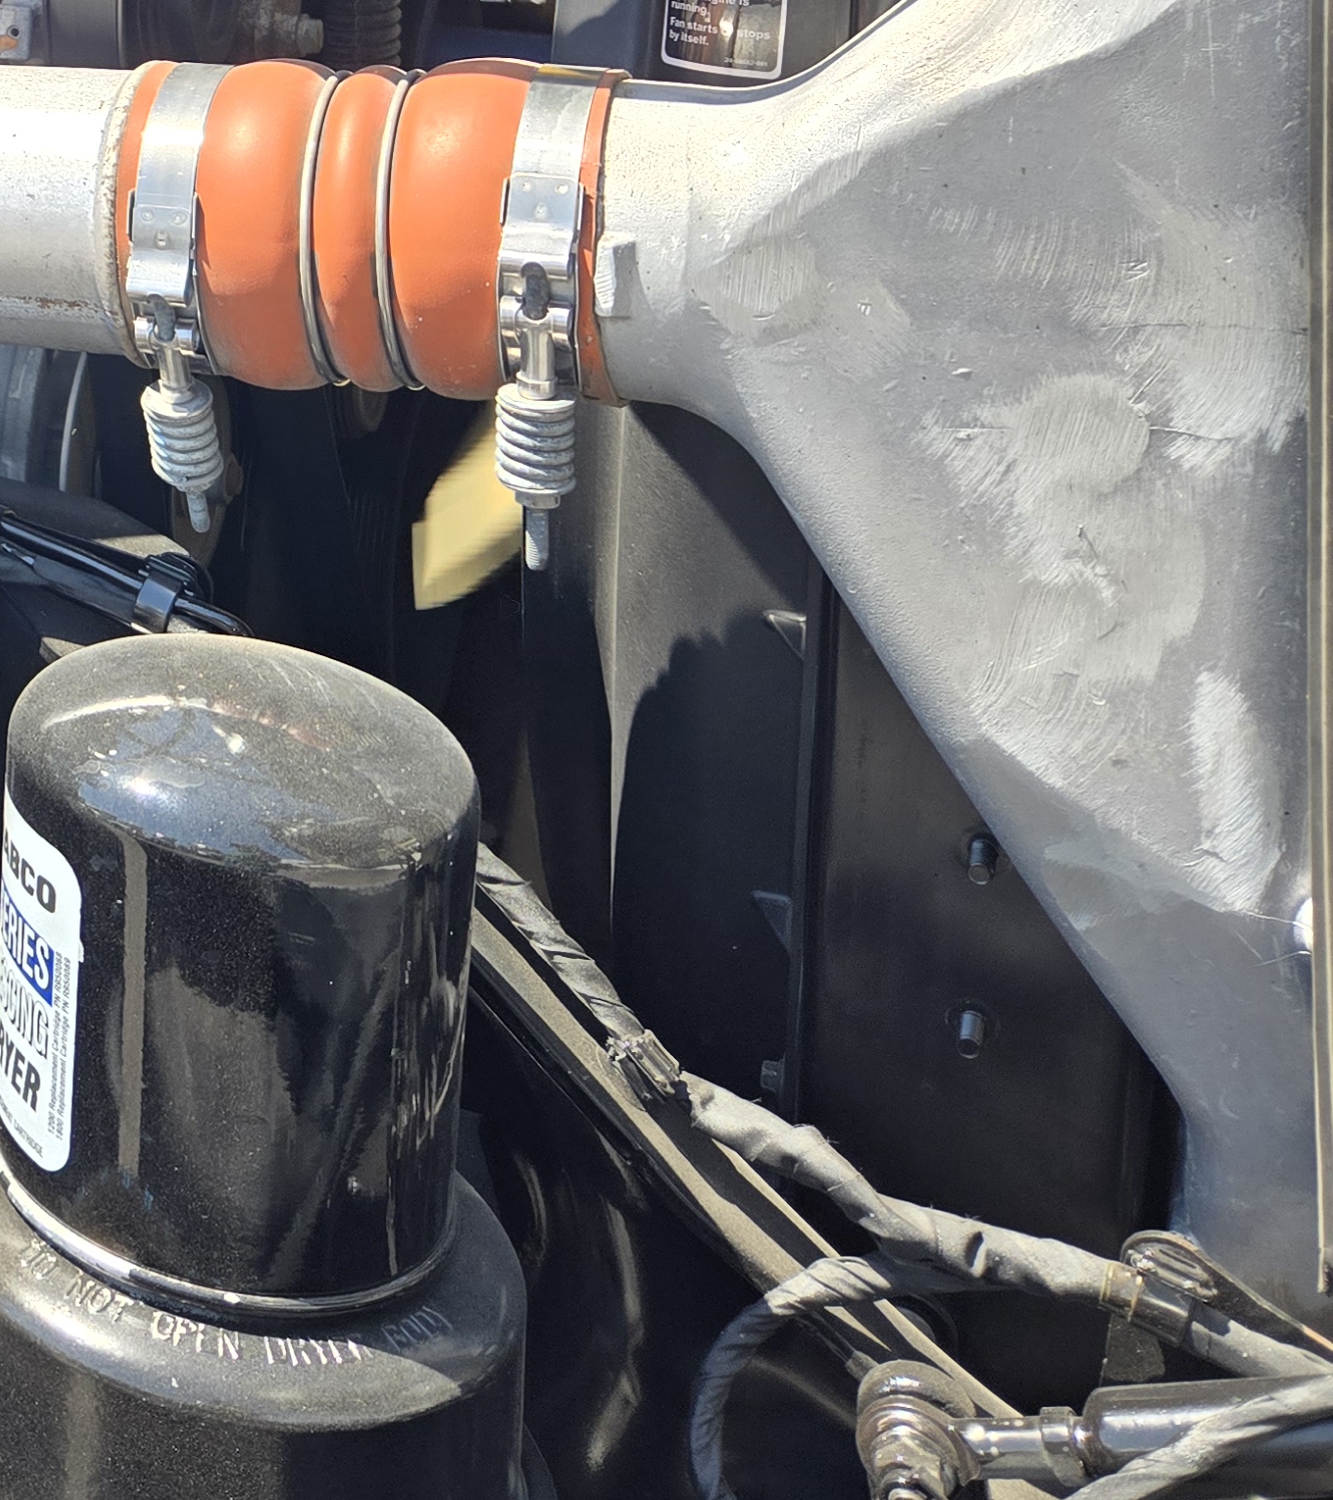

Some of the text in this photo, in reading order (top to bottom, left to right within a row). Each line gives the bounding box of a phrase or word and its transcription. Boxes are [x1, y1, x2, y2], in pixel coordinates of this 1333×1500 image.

[669, 16, 686, 28] Fan
[686, 20, 719, 35] starts
[669, 29, 710, 46] by itself.
[737, 29, 771, 41] stops
[67, 1270, 133, 1324] NOT
